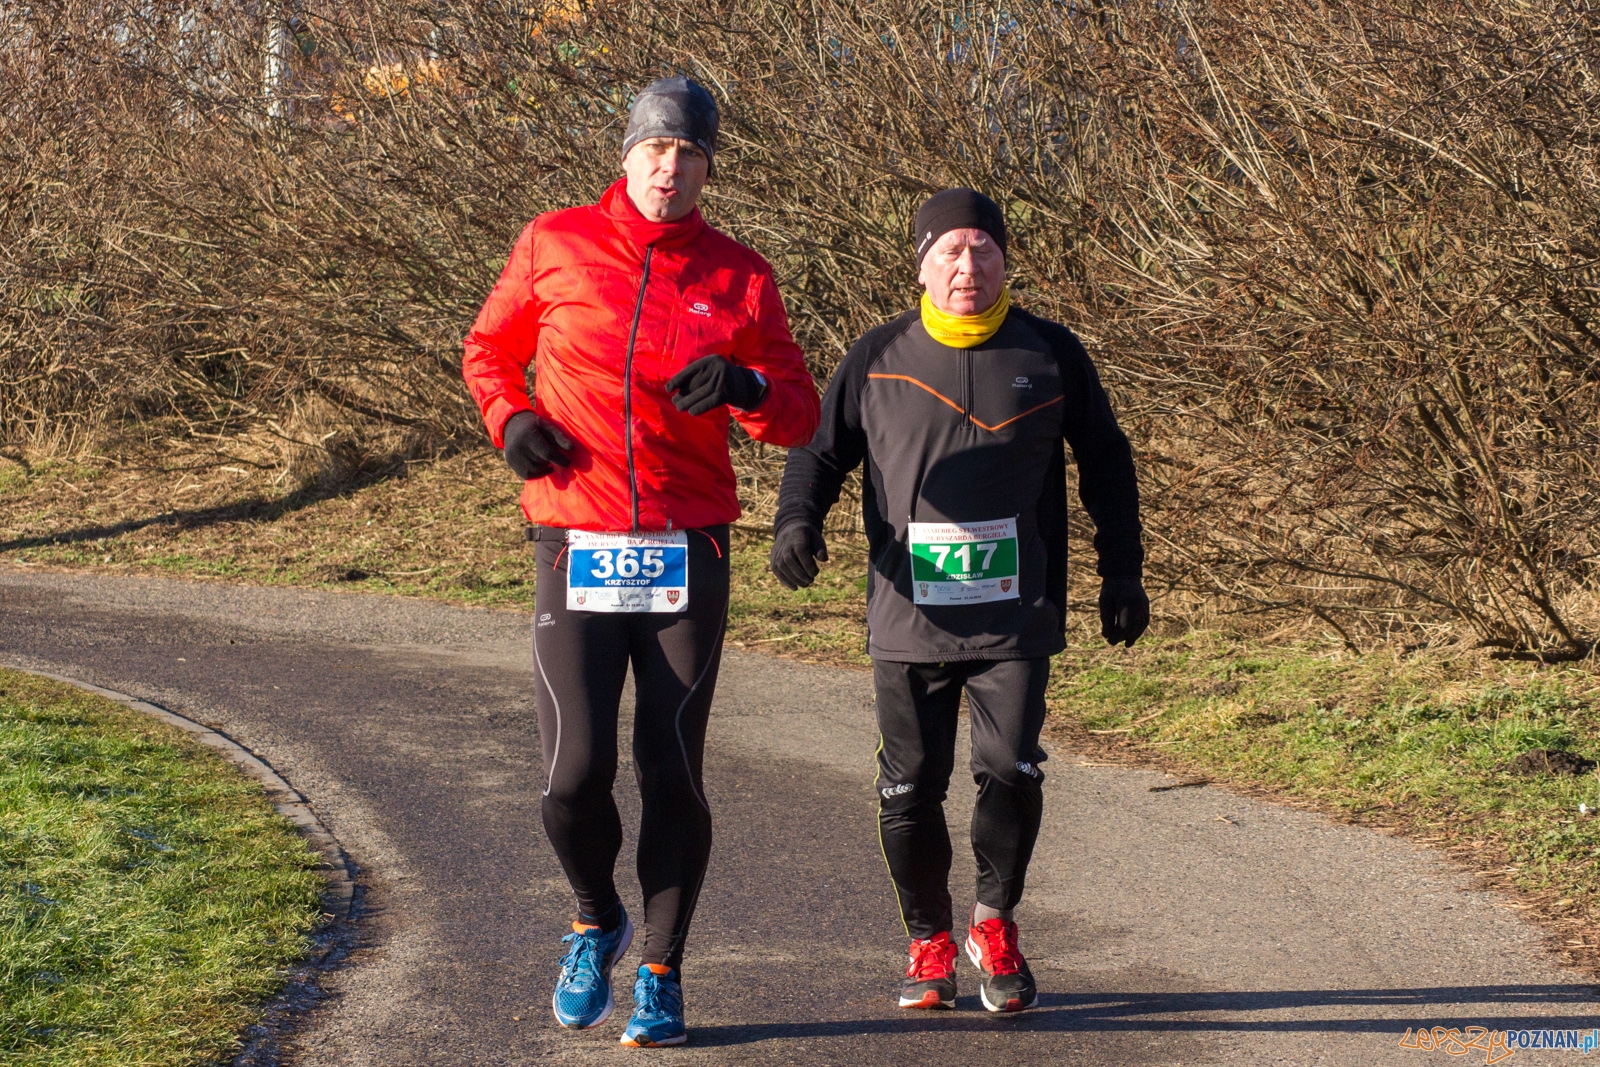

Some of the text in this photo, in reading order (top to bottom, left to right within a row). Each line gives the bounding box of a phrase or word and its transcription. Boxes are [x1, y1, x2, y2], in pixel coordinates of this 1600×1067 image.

[959, 523, 1008, 534] SYLWESTROWY
[973, 531, 1007, 541] BURGIELA
[929, 542, 998, 573] 717
[590, 549, 665, 579] 365
[945, 572, 984, 581] ZDZISŁAW
